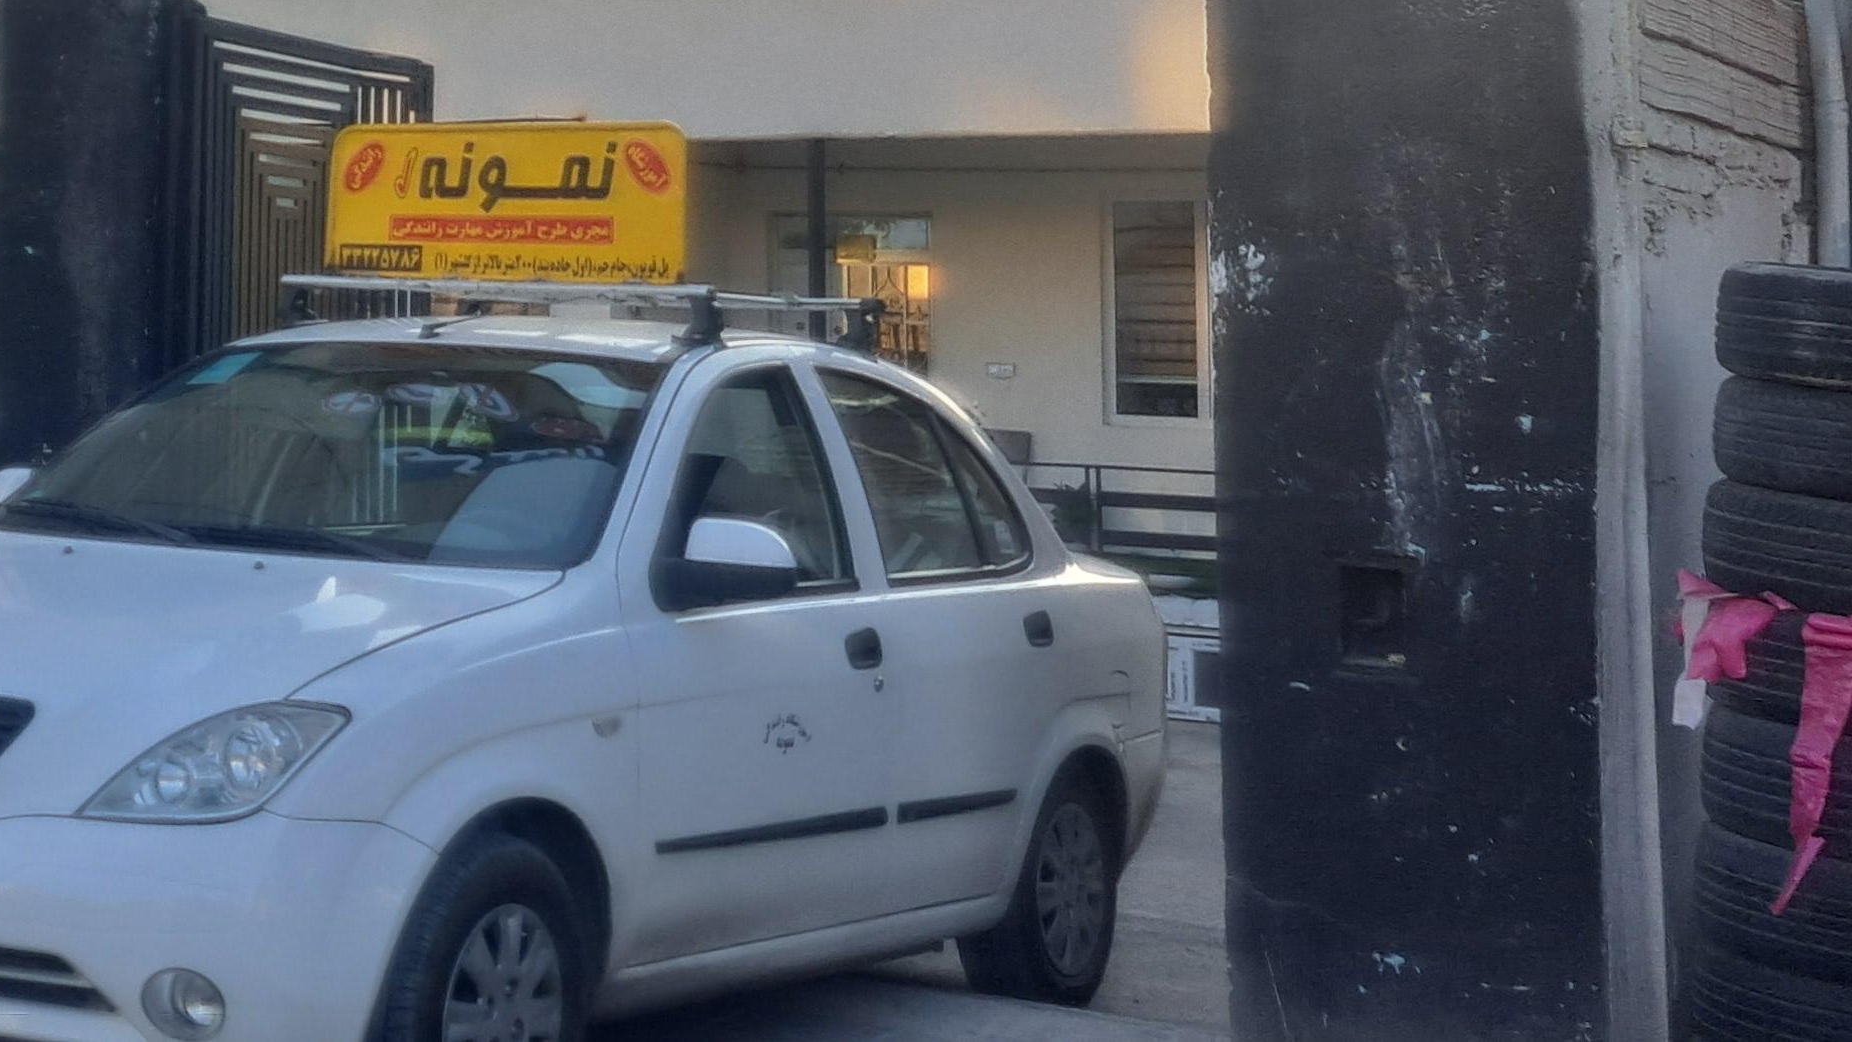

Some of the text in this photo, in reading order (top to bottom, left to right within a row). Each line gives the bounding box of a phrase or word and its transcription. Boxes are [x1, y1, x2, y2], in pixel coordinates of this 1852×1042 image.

[392, 219, 444, 240] رانندگی
[485, 219, 533, 240] آموزش
[536, 221, 568, 240] طرح
[570, 222, 609, 240] مجری
